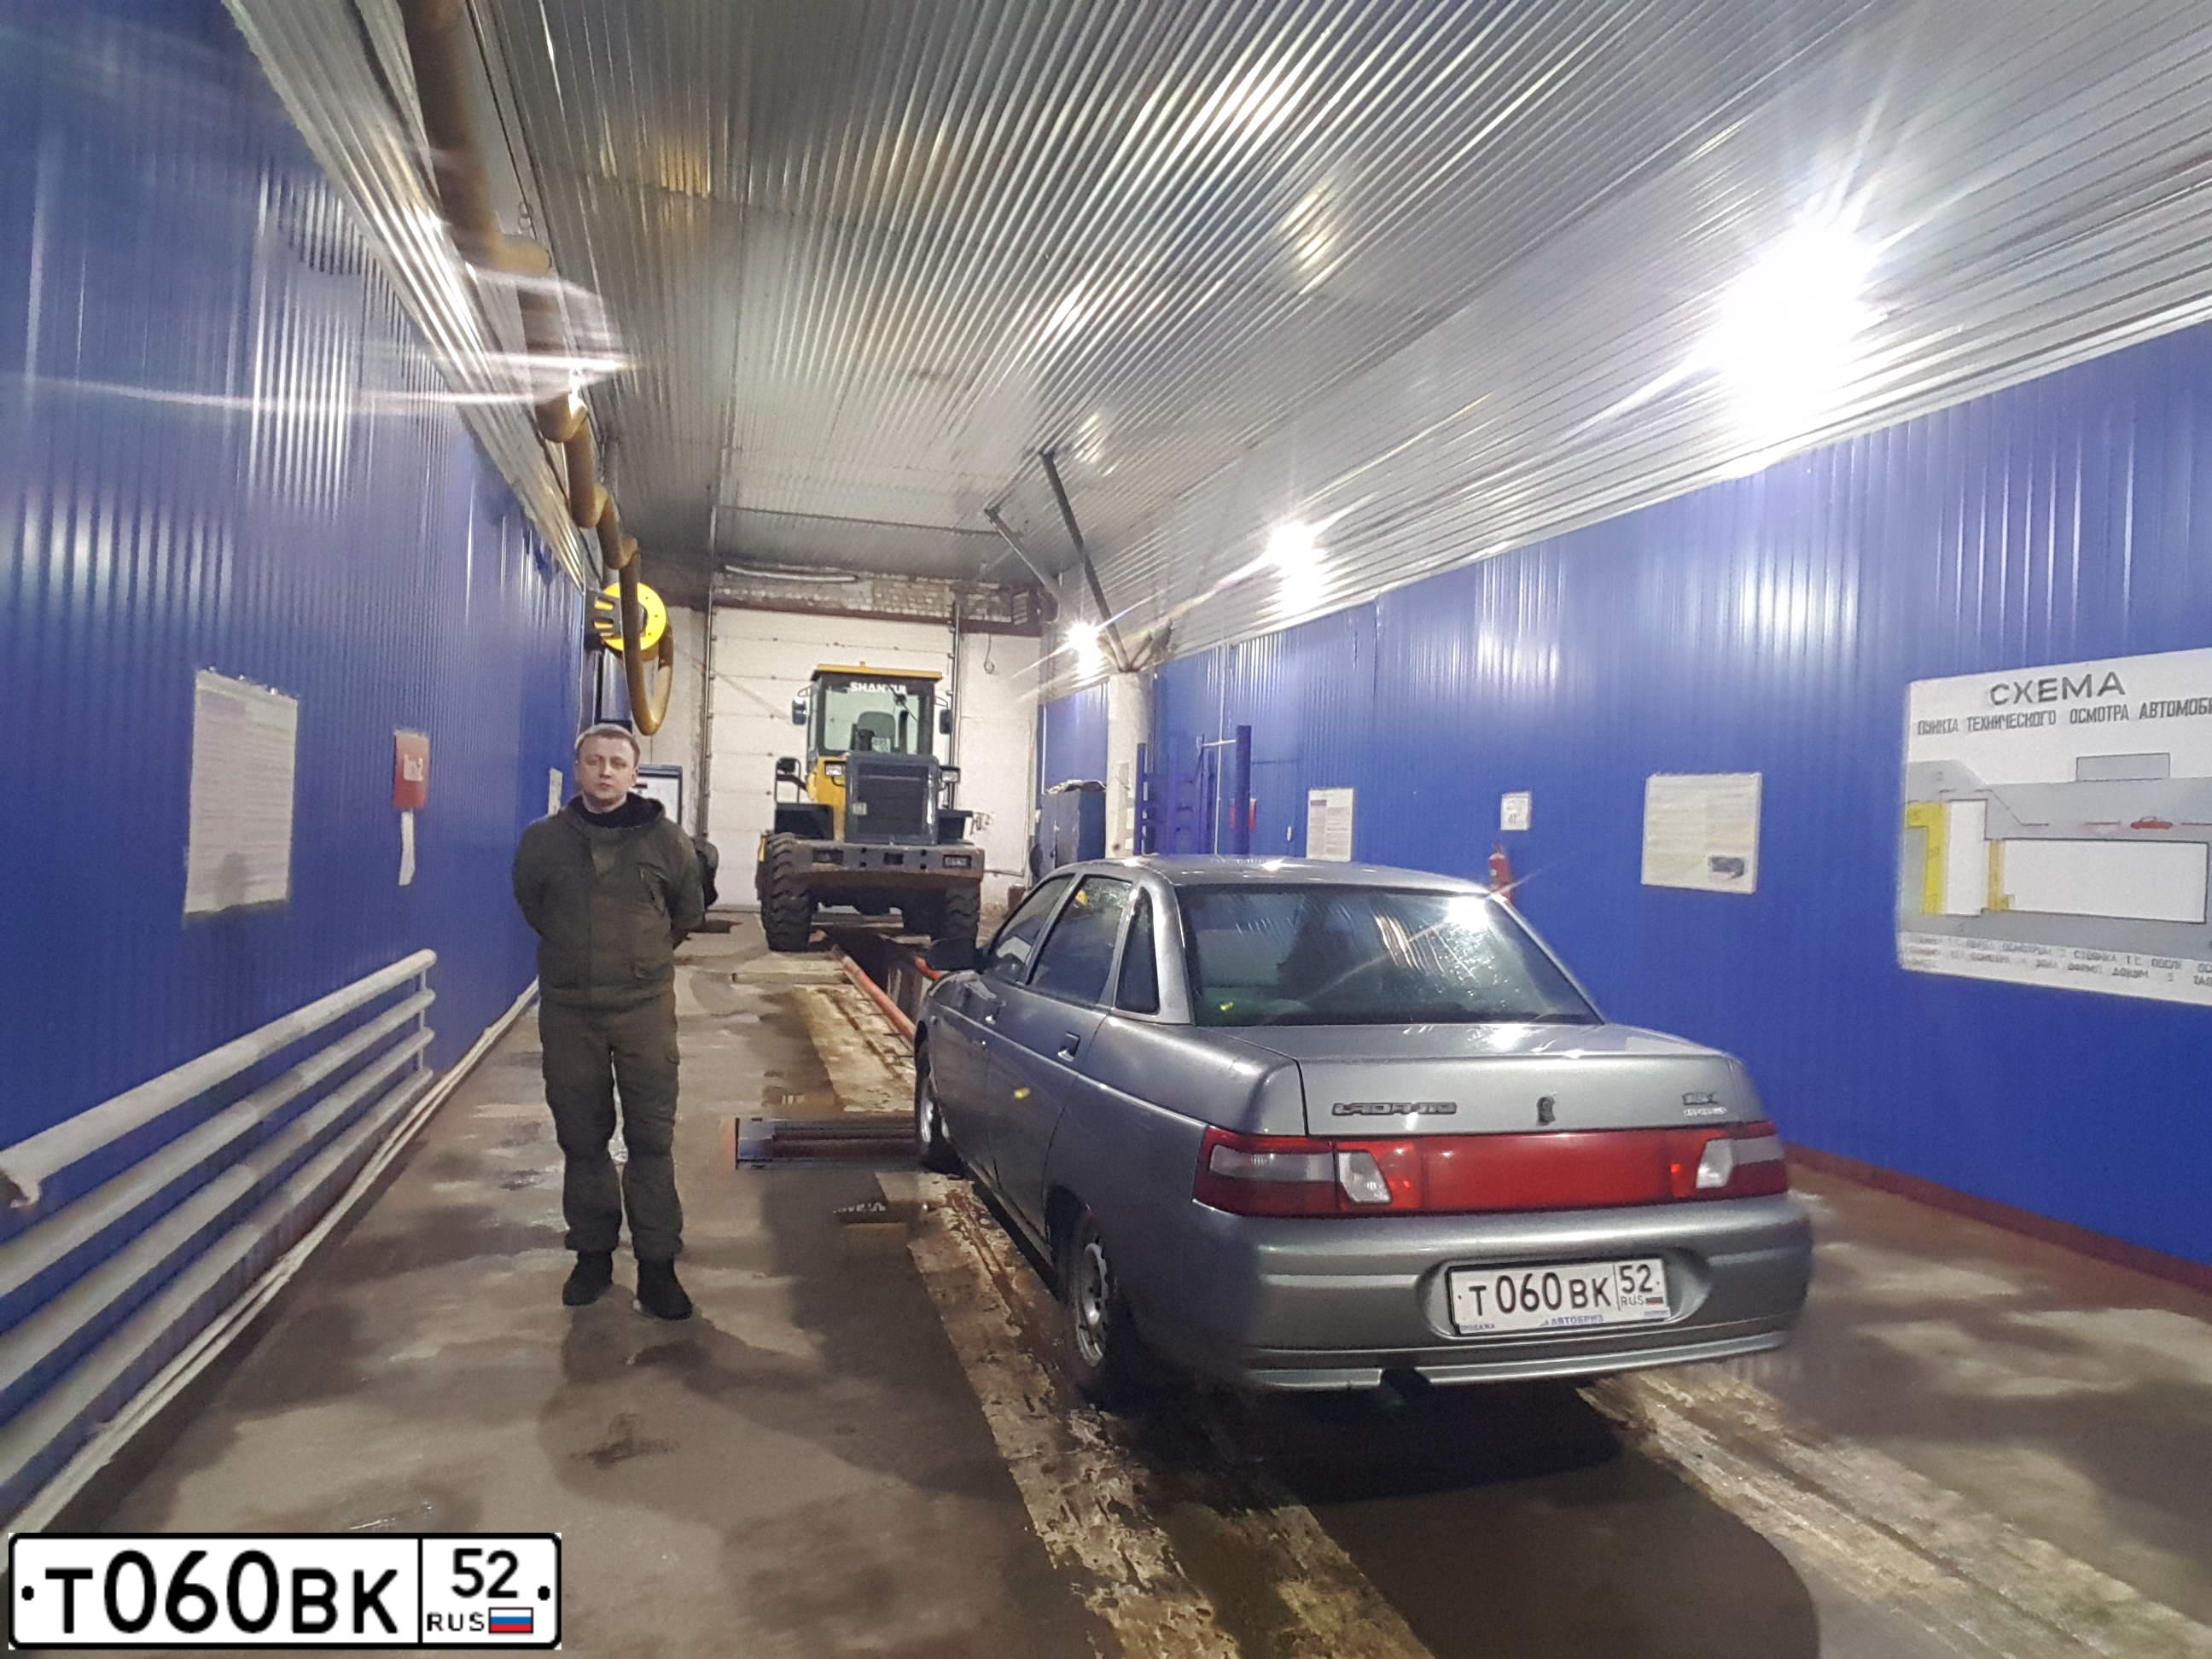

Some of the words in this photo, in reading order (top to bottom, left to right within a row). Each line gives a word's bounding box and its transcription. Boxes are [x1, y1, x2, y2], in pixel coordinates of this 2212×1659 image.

[1989, 671, 2126, 706] СХЕМА
[1966, 710, 2057, 734] ТЕХНИЧЕСКОГО
[2069, 703, 2130, 725] ОСМОТРА
[1618, 1264, 1653, 1294] 52
[1621, 1295, 1644, 1306] RUS
